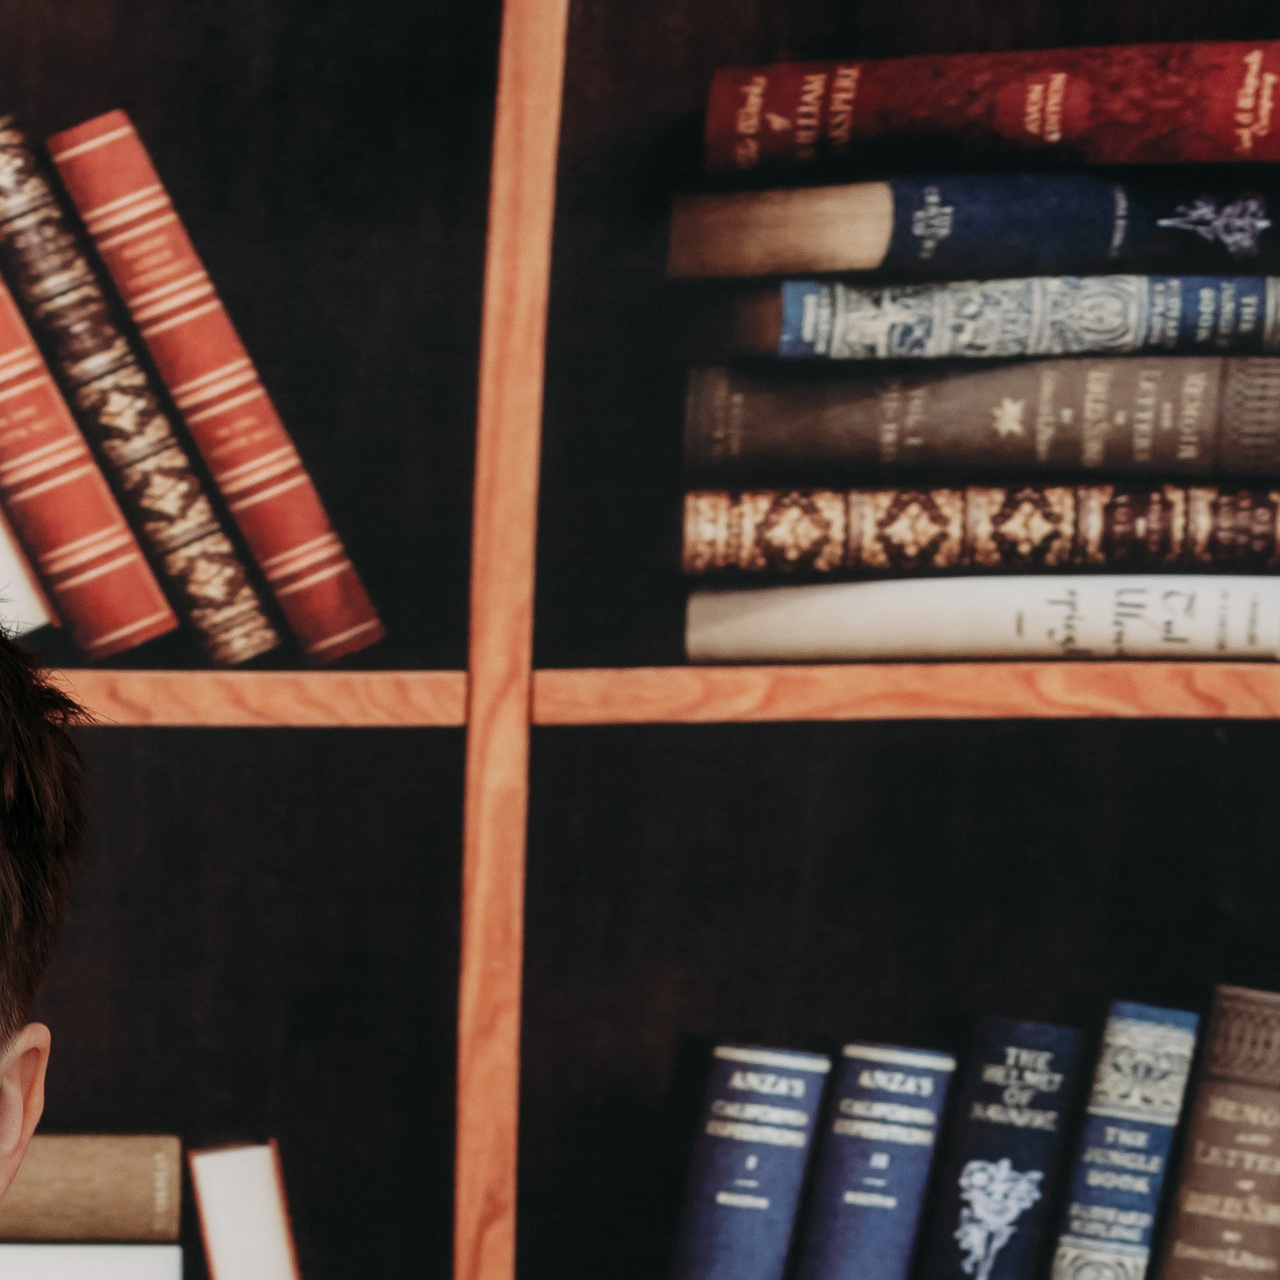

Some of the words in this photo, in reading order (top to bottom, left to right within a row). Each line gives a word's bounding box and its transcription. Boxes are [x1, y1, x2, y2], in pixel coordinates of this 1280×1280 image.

[1004, 1046, 1055, 1071] THE
[728, 1070, 807, 1099] ANZA'S
[857, 1069, 934, 1098] ANZA'S
[1105, 1125, 1150, 1149] THE
